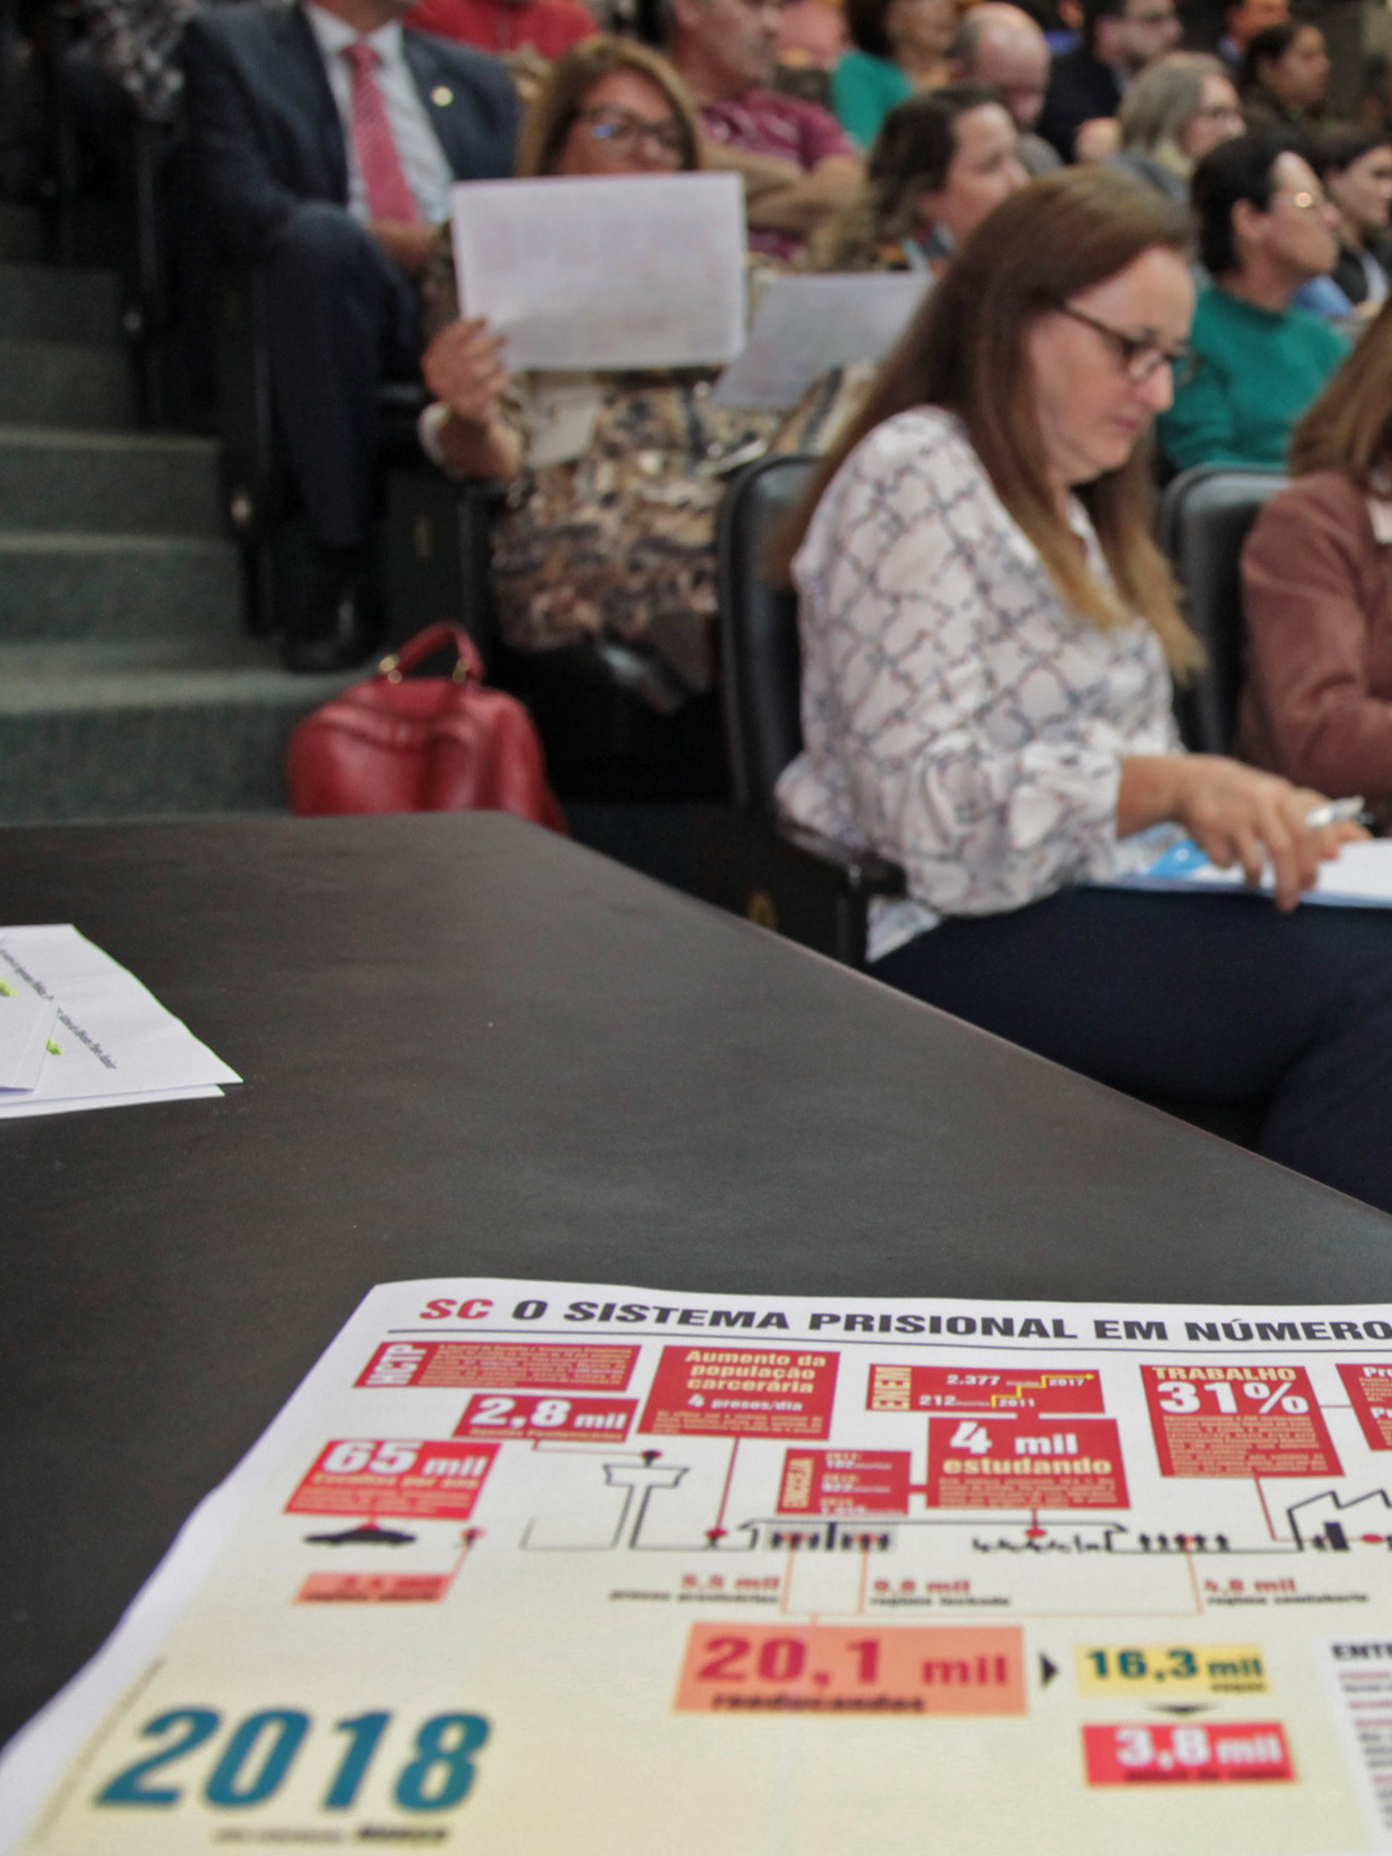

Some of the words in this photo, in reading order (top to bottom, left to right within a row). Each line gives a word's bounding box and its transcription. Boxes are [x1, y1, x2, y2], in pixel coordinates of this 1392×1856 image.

[419, 1298, 494, 1320] SC
[512, 1299, 548, 1320] O
[563, 1301, 789, 1330] SISTEMA
[809, 1312, 1078, 1340] PRISIONAL
[1095, 1319, 1168, 1342] EM
[365, 1343, 428, 1386] HCTP
[684, 1349, 791, 1366] Aumento
[797, 1353, 827, 1367] da
[686, 1376, 814, 1394] carcerária
[689, 1364, 816, 1381] população
[946, 1374, 1001, 1386] 2.377
[1048, 1378, 1085, 1387] 2017
[1151, 1366, 1297, 1381] TRABALHO
[687, 1393, 705, 1408] 4
[918, 1394, 957, 1407] 212
[998, 1397, 1036, 1408] 2011
[1156, 1381, 1310, 1414] 31%
[469, 1396, 573, 1430] 2,8
[573, 1411, 627, 1430] mil
[950, 1421, 993, 1455] 4
[1014, 1433, 1079, 1455] mil
[322, 1440, 424, 1476] 65
[420, 1455, 489, 1478] mil
[942, 1457, 1113, 1475] estudando
[697, 1636, 881, 1689] 20,1
[921, 1656, 1010, 1686] mil
[1088, 1648, 1200, 1684] 16,3
[1206, 1657, 1264, 1679] mil
[94, 1703, 492, 1814] 2018
[1214, 1733, 1285, 1766] mil
